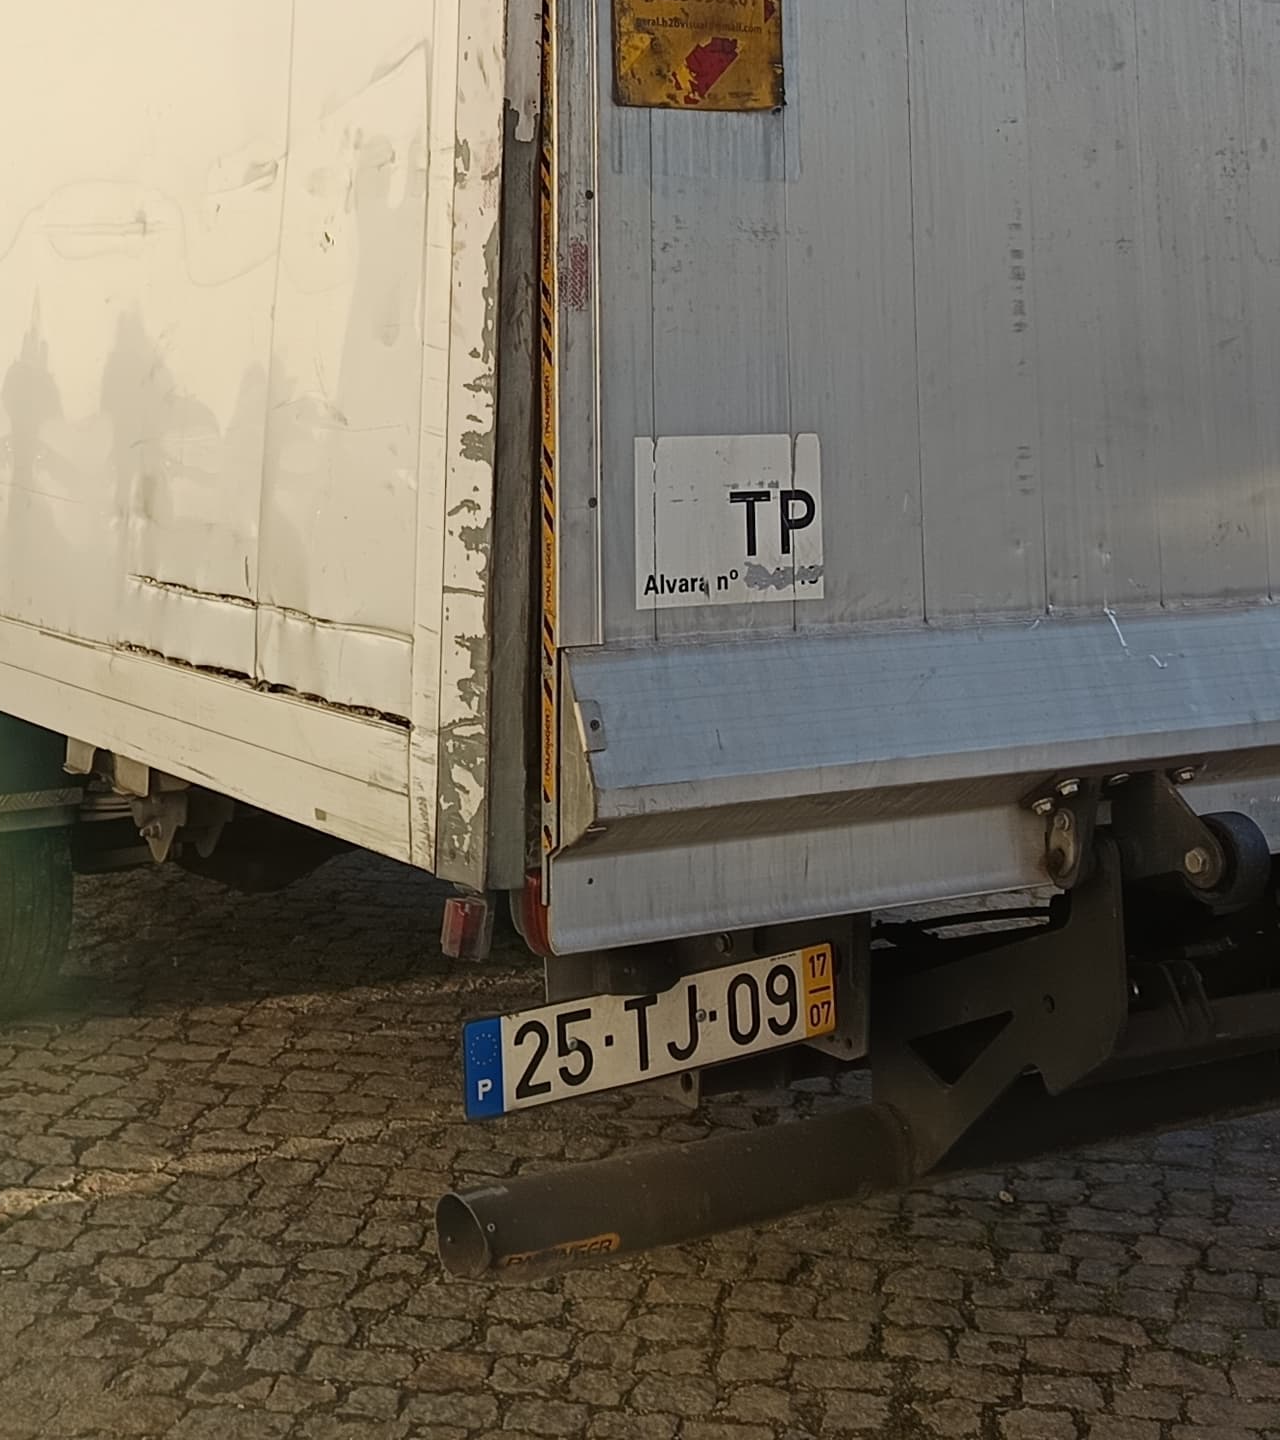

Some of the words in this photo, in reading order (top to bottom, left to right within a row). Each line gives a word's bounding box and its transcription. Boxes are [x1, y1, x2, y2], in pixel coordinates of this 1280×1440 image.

[729, 489, 816, 556] TP
[809, 951, 827, 978] 17
[810, 1000, 832, 1028] 07
[477, 1078, 492, 1101] P
